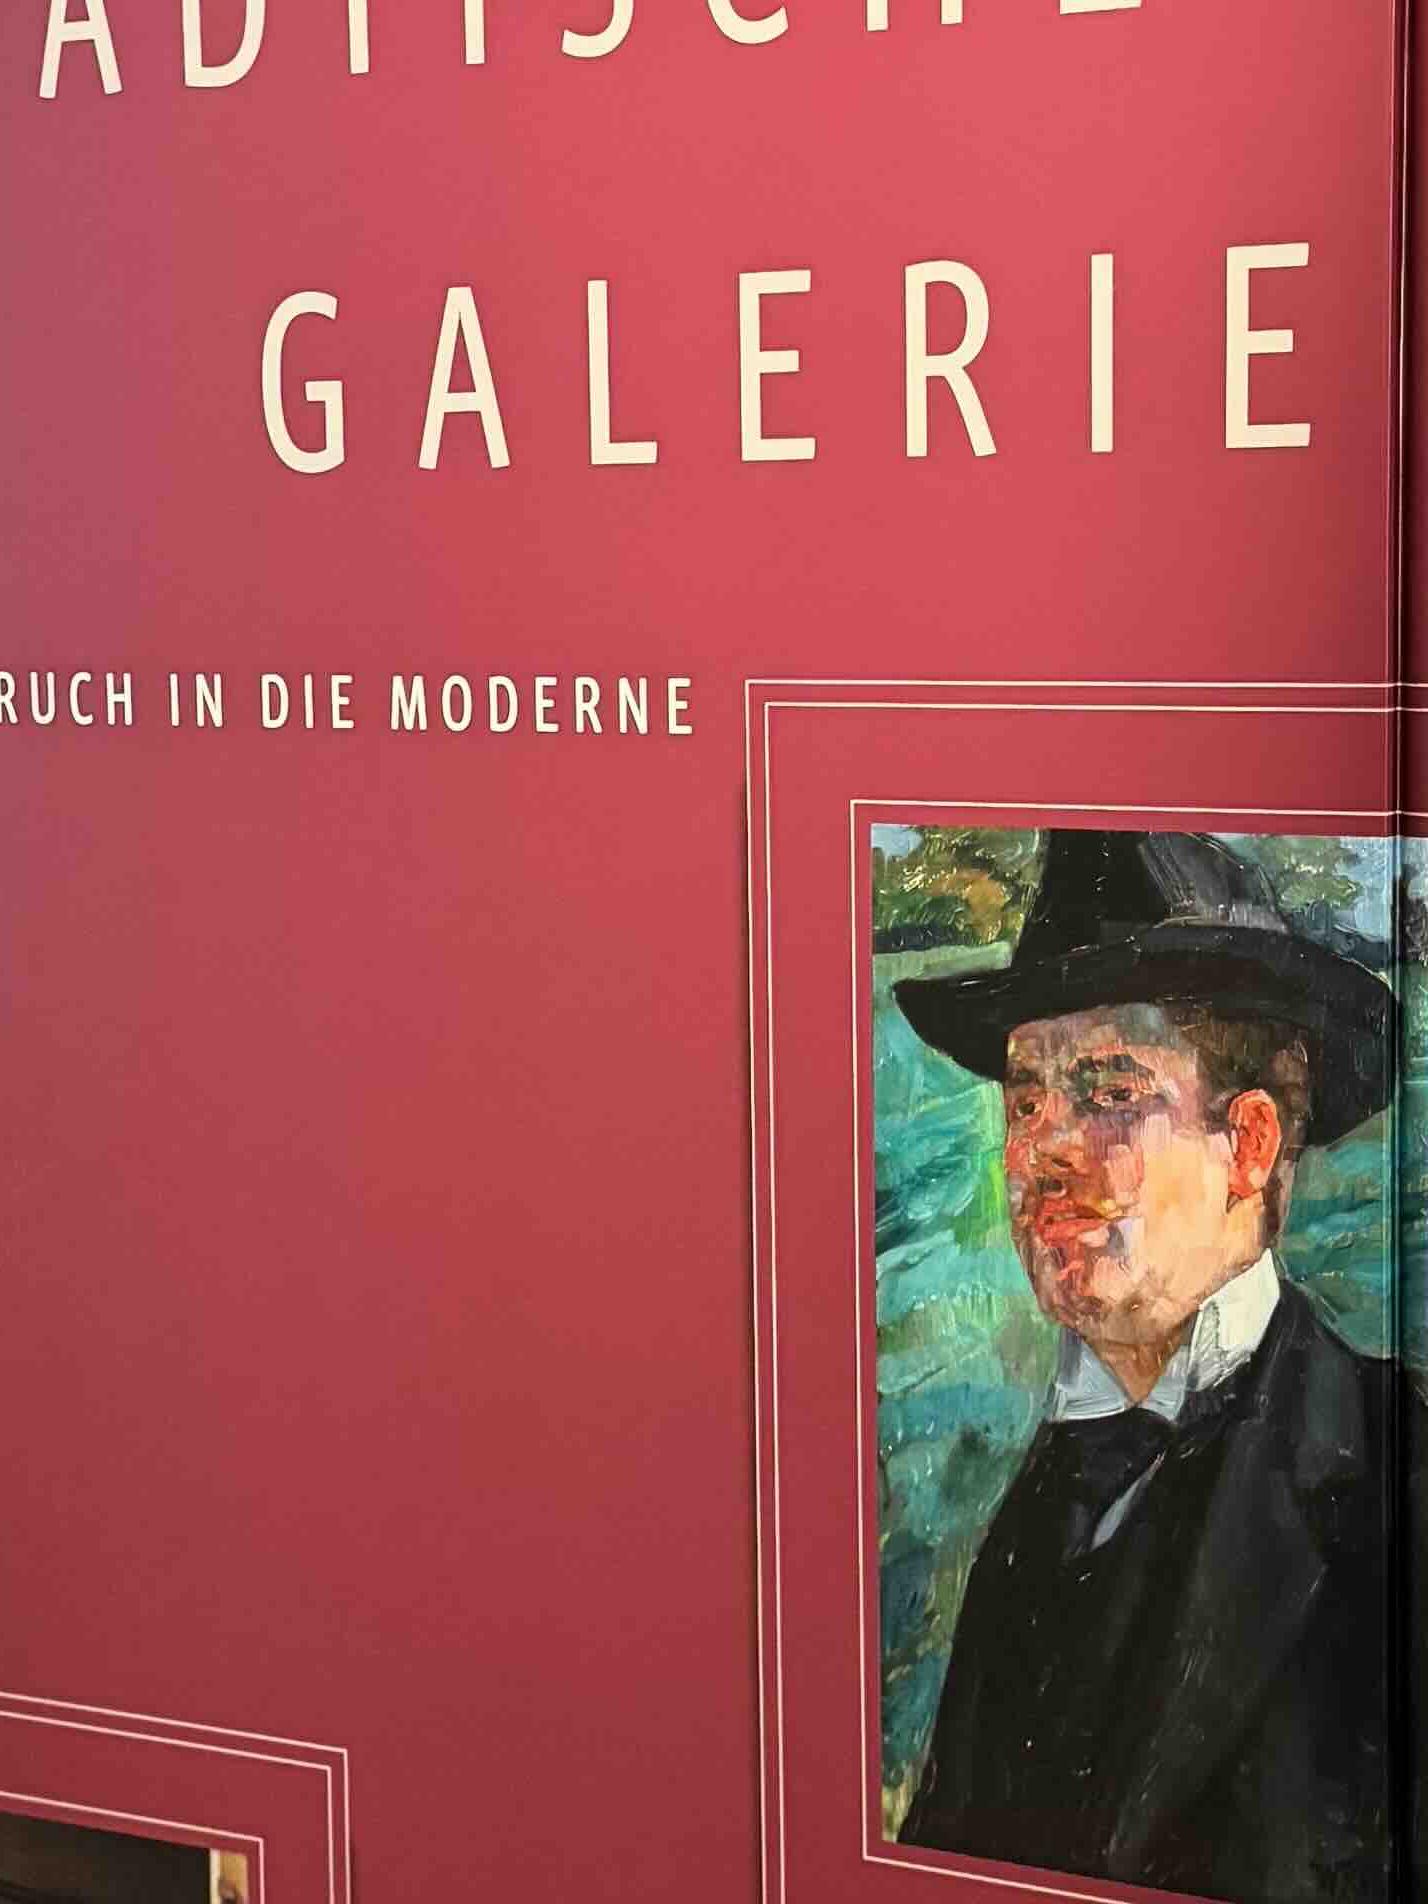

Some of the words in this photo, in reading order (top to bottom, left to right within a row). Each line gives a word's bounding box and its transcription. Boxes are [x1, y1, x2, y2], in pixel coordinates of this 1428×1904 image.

[260, 241, 1312, 475] GALERIE
[168, 672, 224, 729] IN
[260, 673, 355, 730] DIE
[389, 674, 694, 736] MODERNE
